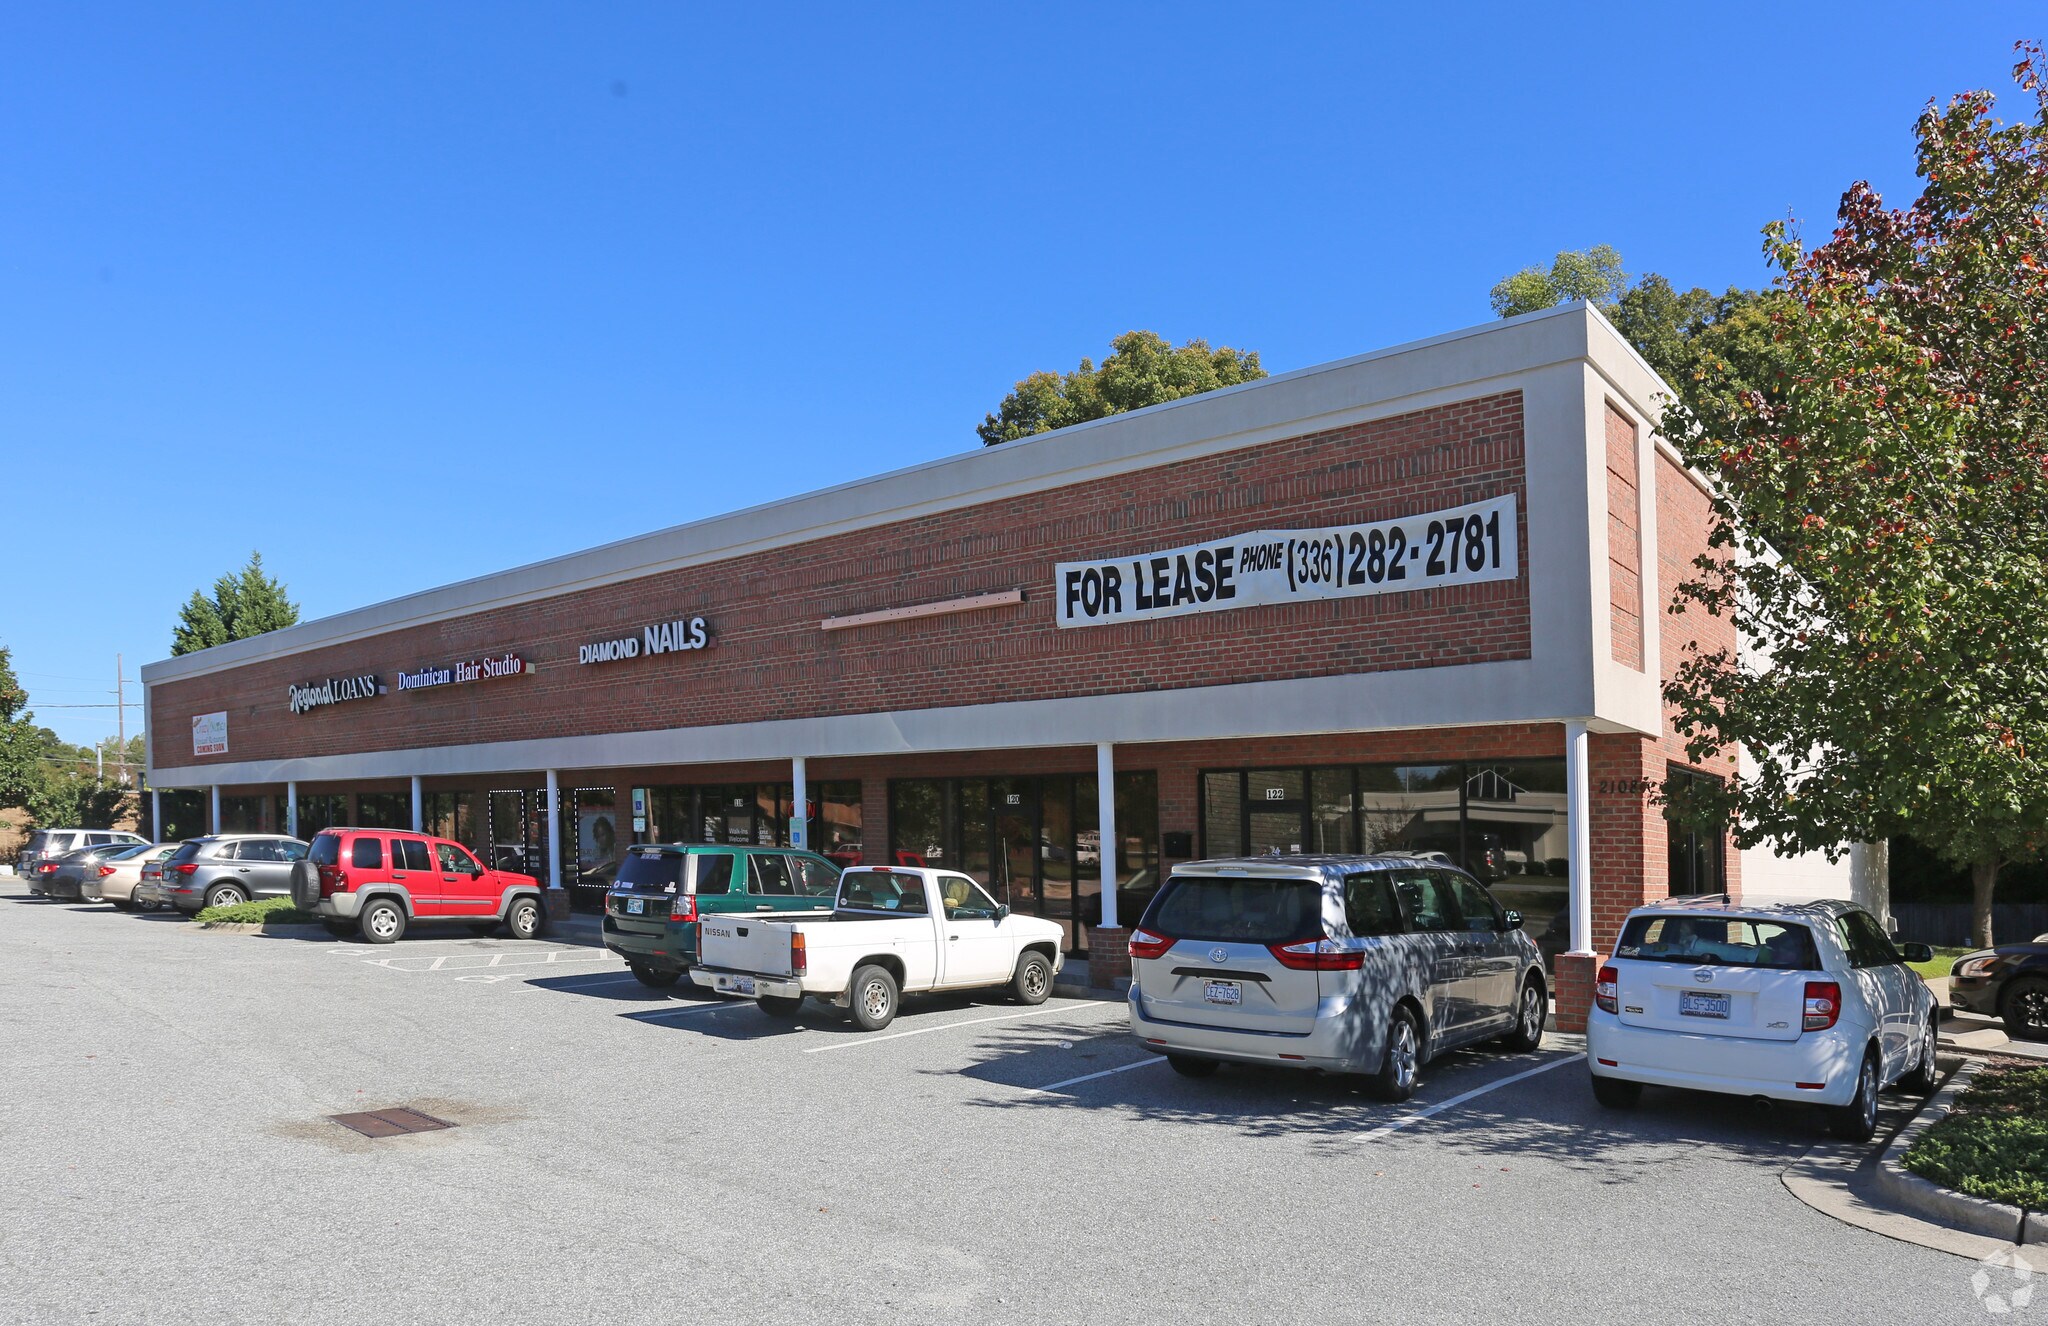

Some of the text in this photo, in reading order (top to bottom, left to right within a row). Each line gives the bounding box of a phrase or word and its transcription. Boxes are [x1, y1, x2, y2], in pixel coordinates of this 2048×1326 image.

[1066, 566, 1122, 618] FOR
[1133, 546, 1236, 611] LEASE
[1239, 542, 1284, 574] PHONE
[579, 617, 706, 664] DIAMOND NAILS
[398, 653, 521, 690] Dominican Hair Studio
[289, 675, 375, 714] Regional LOANS
[1267, 789, 1283, 799] 122
[704, 927, 731, 938] NISSAN
[1205, 986, 1239, 1000] CEZ-7628
[1682, 997, 1728, 1013] BLS-3500
